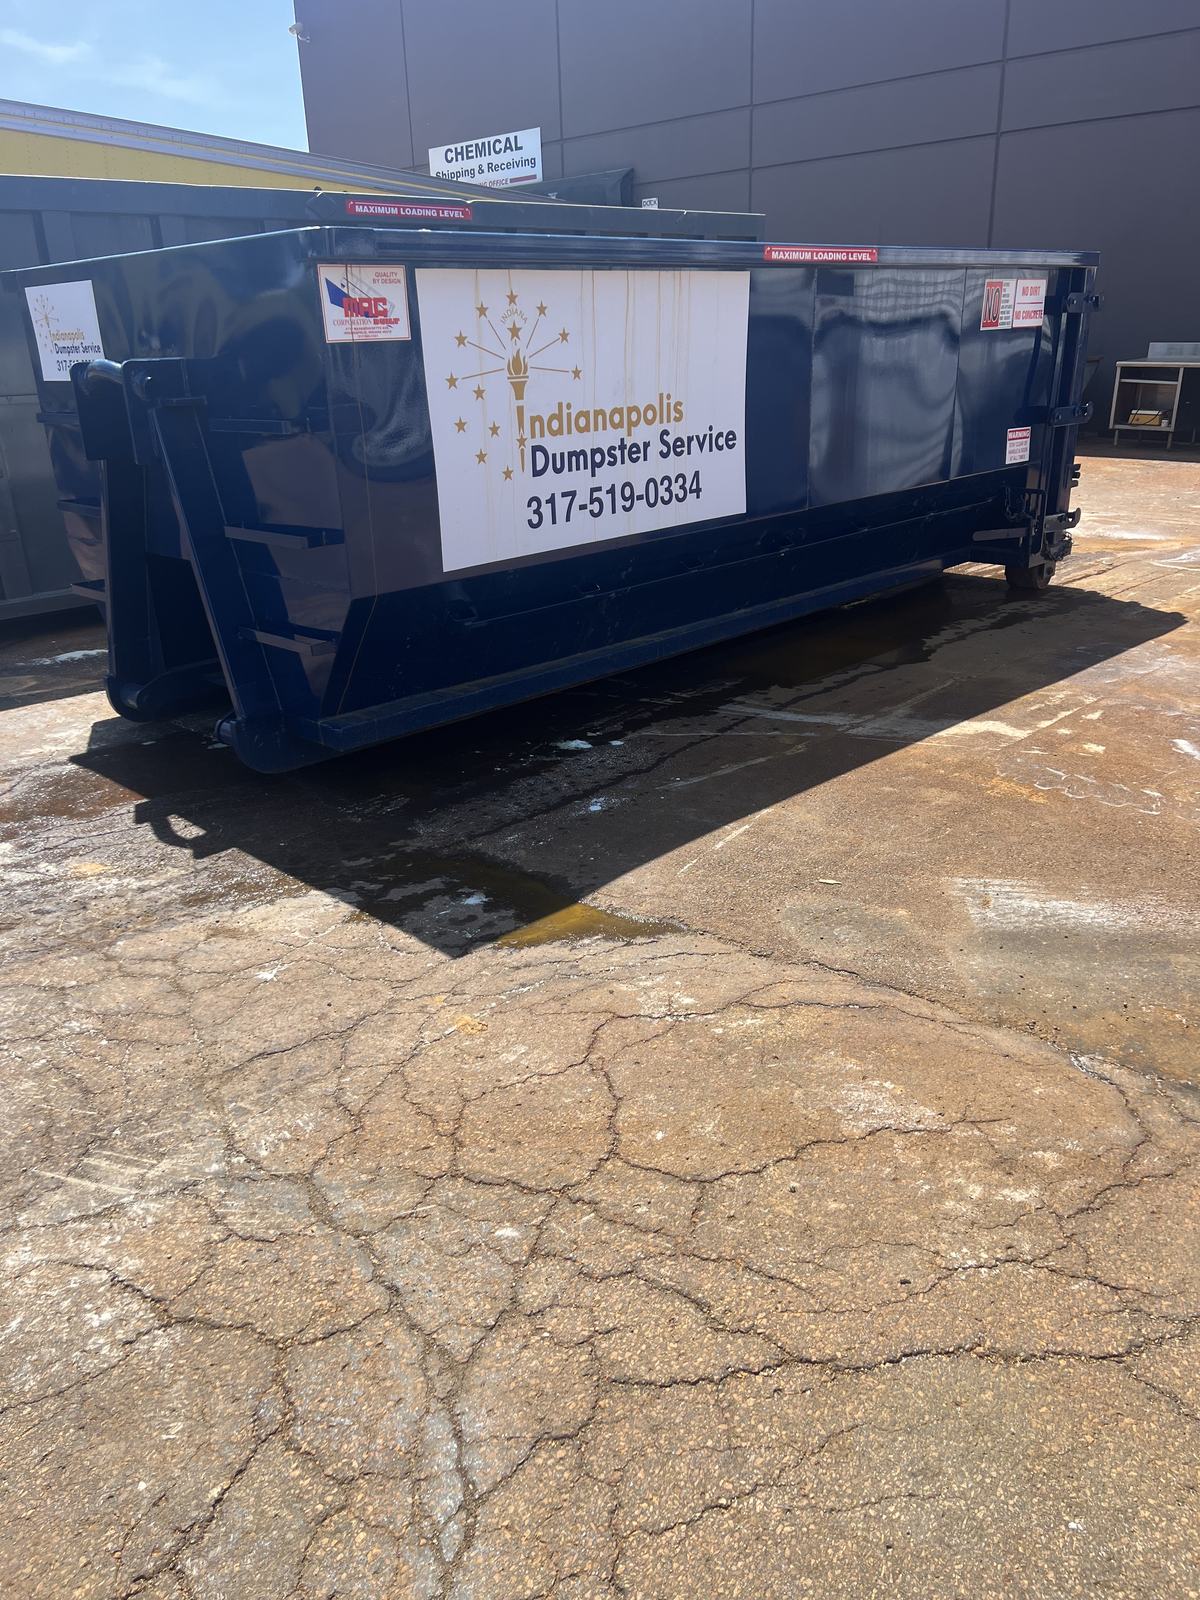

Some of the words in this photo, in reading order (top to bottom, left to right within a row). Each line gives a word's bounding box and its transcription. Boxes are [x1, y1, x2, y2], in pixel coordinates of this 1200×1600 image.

[444, 135, 523, 164] CHEMICAL
[477, 163, 485, 175] &
[487, 156, 536, 173] Receiving
[488, 178, 509, 188] OFFICE
[355, 205, 398, 215] MAXIMUM
[400, 207, 438, 217] LOADING
[439, 210, 464, 218] LEVEL
[771, 250, 812, 260] MAXIMUM
[813, 251, 847, 261] LOADING
[848, 252, 872, 261] LEVEL
[1022, 287, 1030, 297] NO
[1030, 286, 1041, 297] DIRT
[984, 287, 1002, 323] NO
[500, 308, 528, 325] INDIANA
[1014, 311, 1022, 320] NO
[1022, 309, 1043, 320] CONCRETE
[333, 319, 372, 327] CORPORATION
[54, 343, 81, 356] Dumpster
[81, 341, 101, 353] Service
[516, 393, 684, 440] Indianapolis
[531, 437, 651, 478] Dumpster
[658, 425, 737, 459] Service
[527, 470, 702, 530] 317-519-0334
